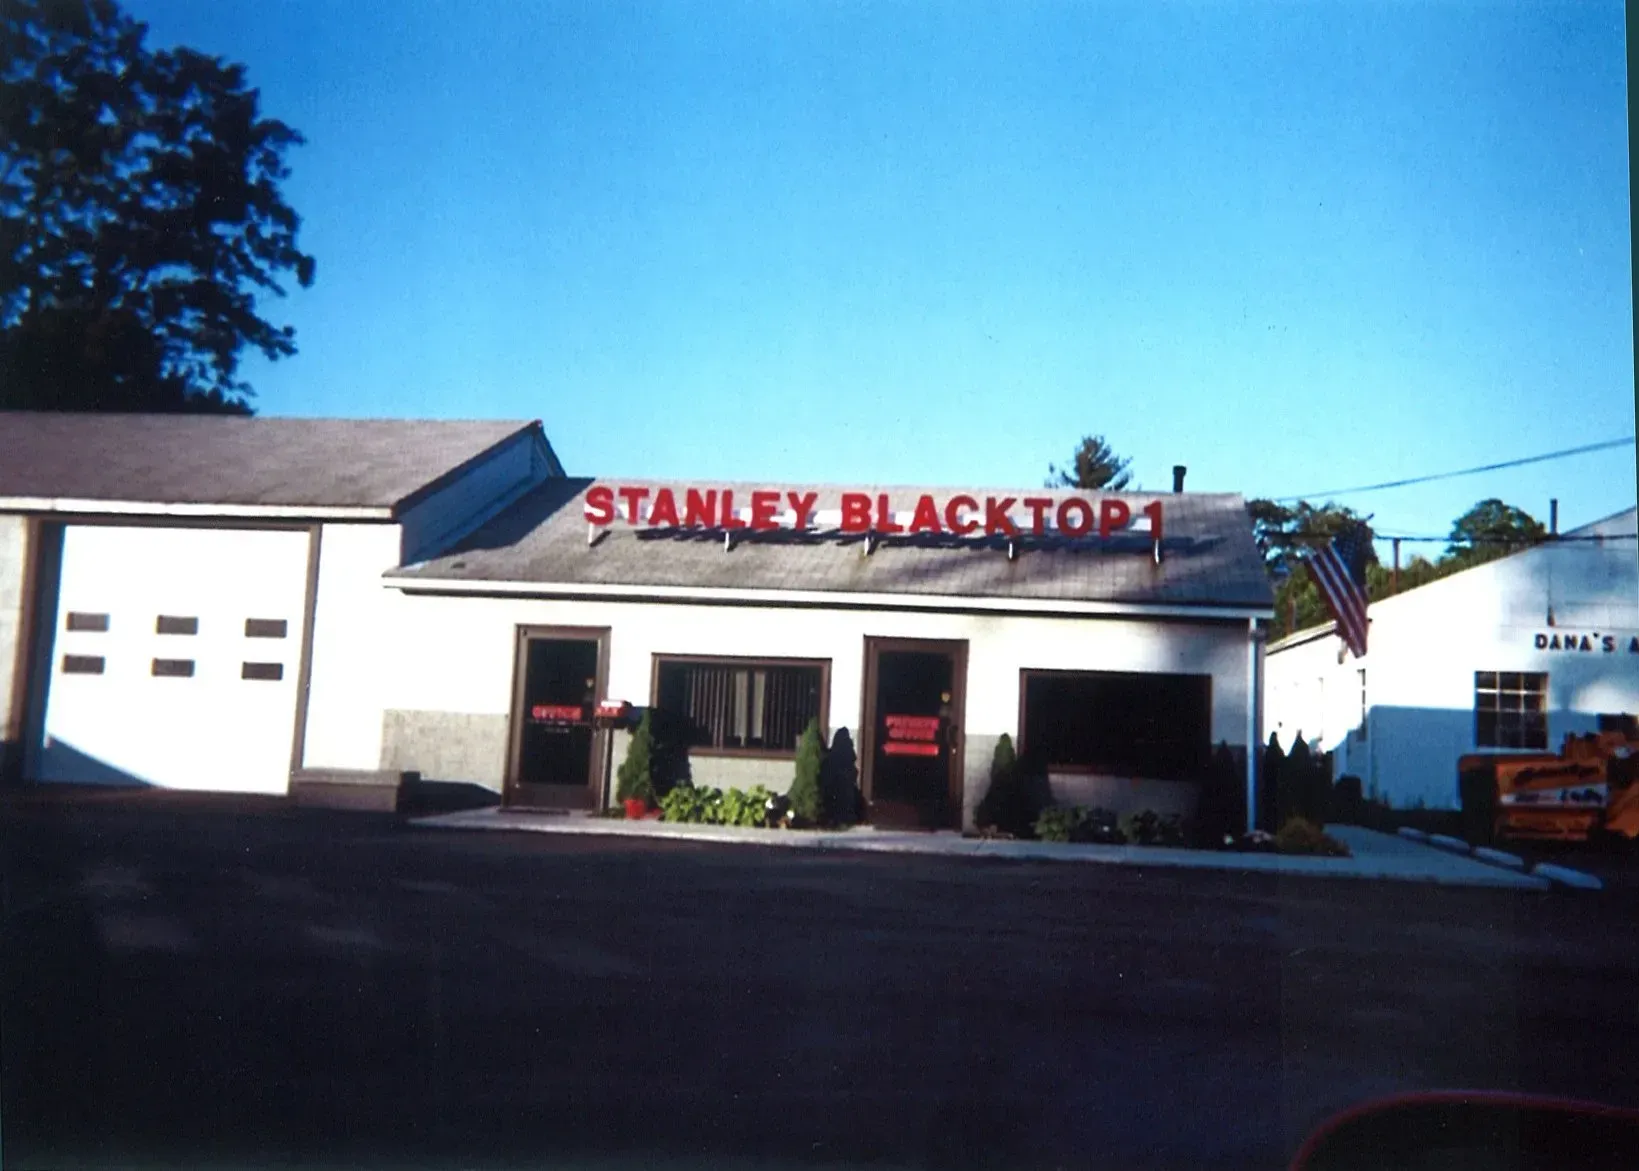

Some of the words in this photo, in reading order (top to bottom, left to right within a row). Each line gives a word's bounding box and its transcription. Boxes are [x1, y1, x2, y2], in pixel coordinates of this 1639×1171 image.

[584, 486, 818, 531] STANLEY
[841, 493, 1132, 540] BLACKTOP
[1144, 500, 1163, 539] 1
[1535, 632, 1616, 653] DANA'S
